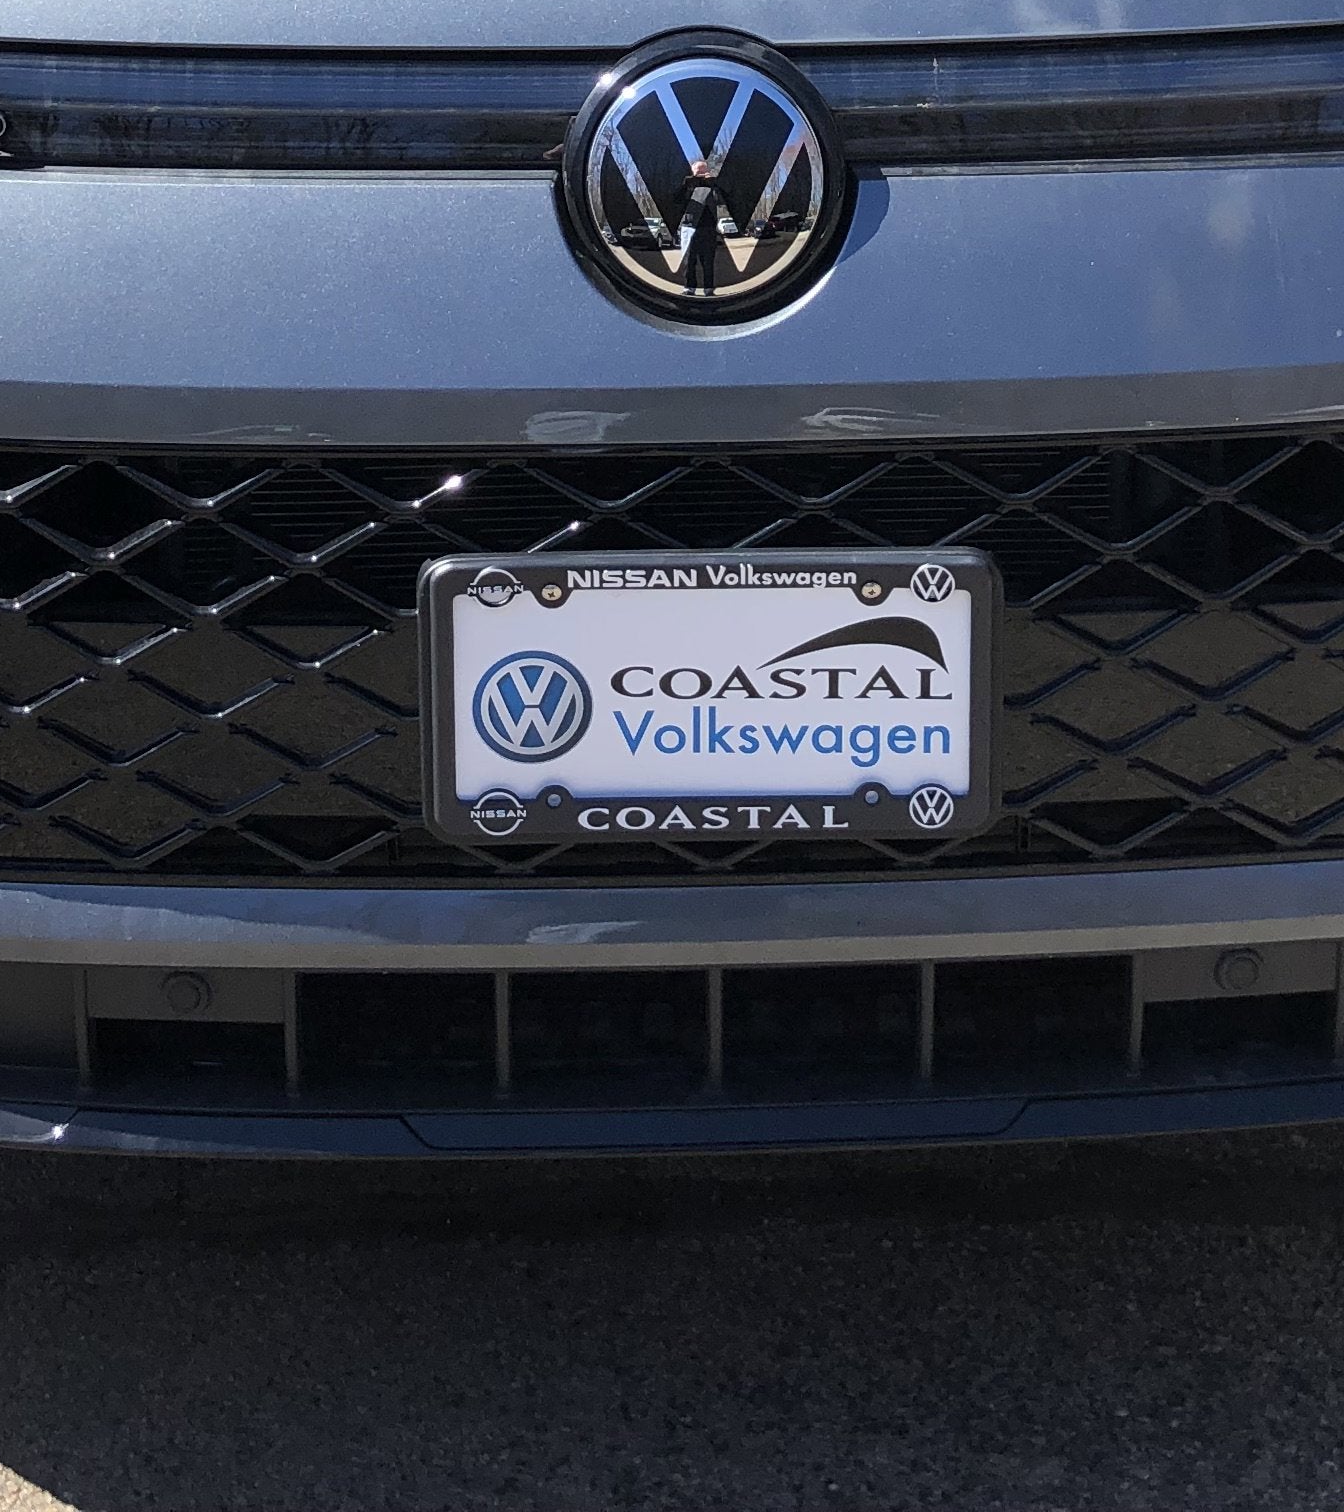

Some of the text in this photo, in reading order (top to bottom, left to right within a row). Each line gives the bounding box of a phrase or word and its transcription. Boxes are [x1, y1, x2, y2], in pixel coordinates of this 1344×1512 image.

[467, 583, 524, 596] NISSAN
[566, 564, 857, 589] NISSAN Volkswagen
[610, 664, 953, 700] COASTAL
[613, 705, 951, 767] Volkswagen
[470, 807, 527, 819] NISSAN
[578, 804, 849, 831] COASTAL
